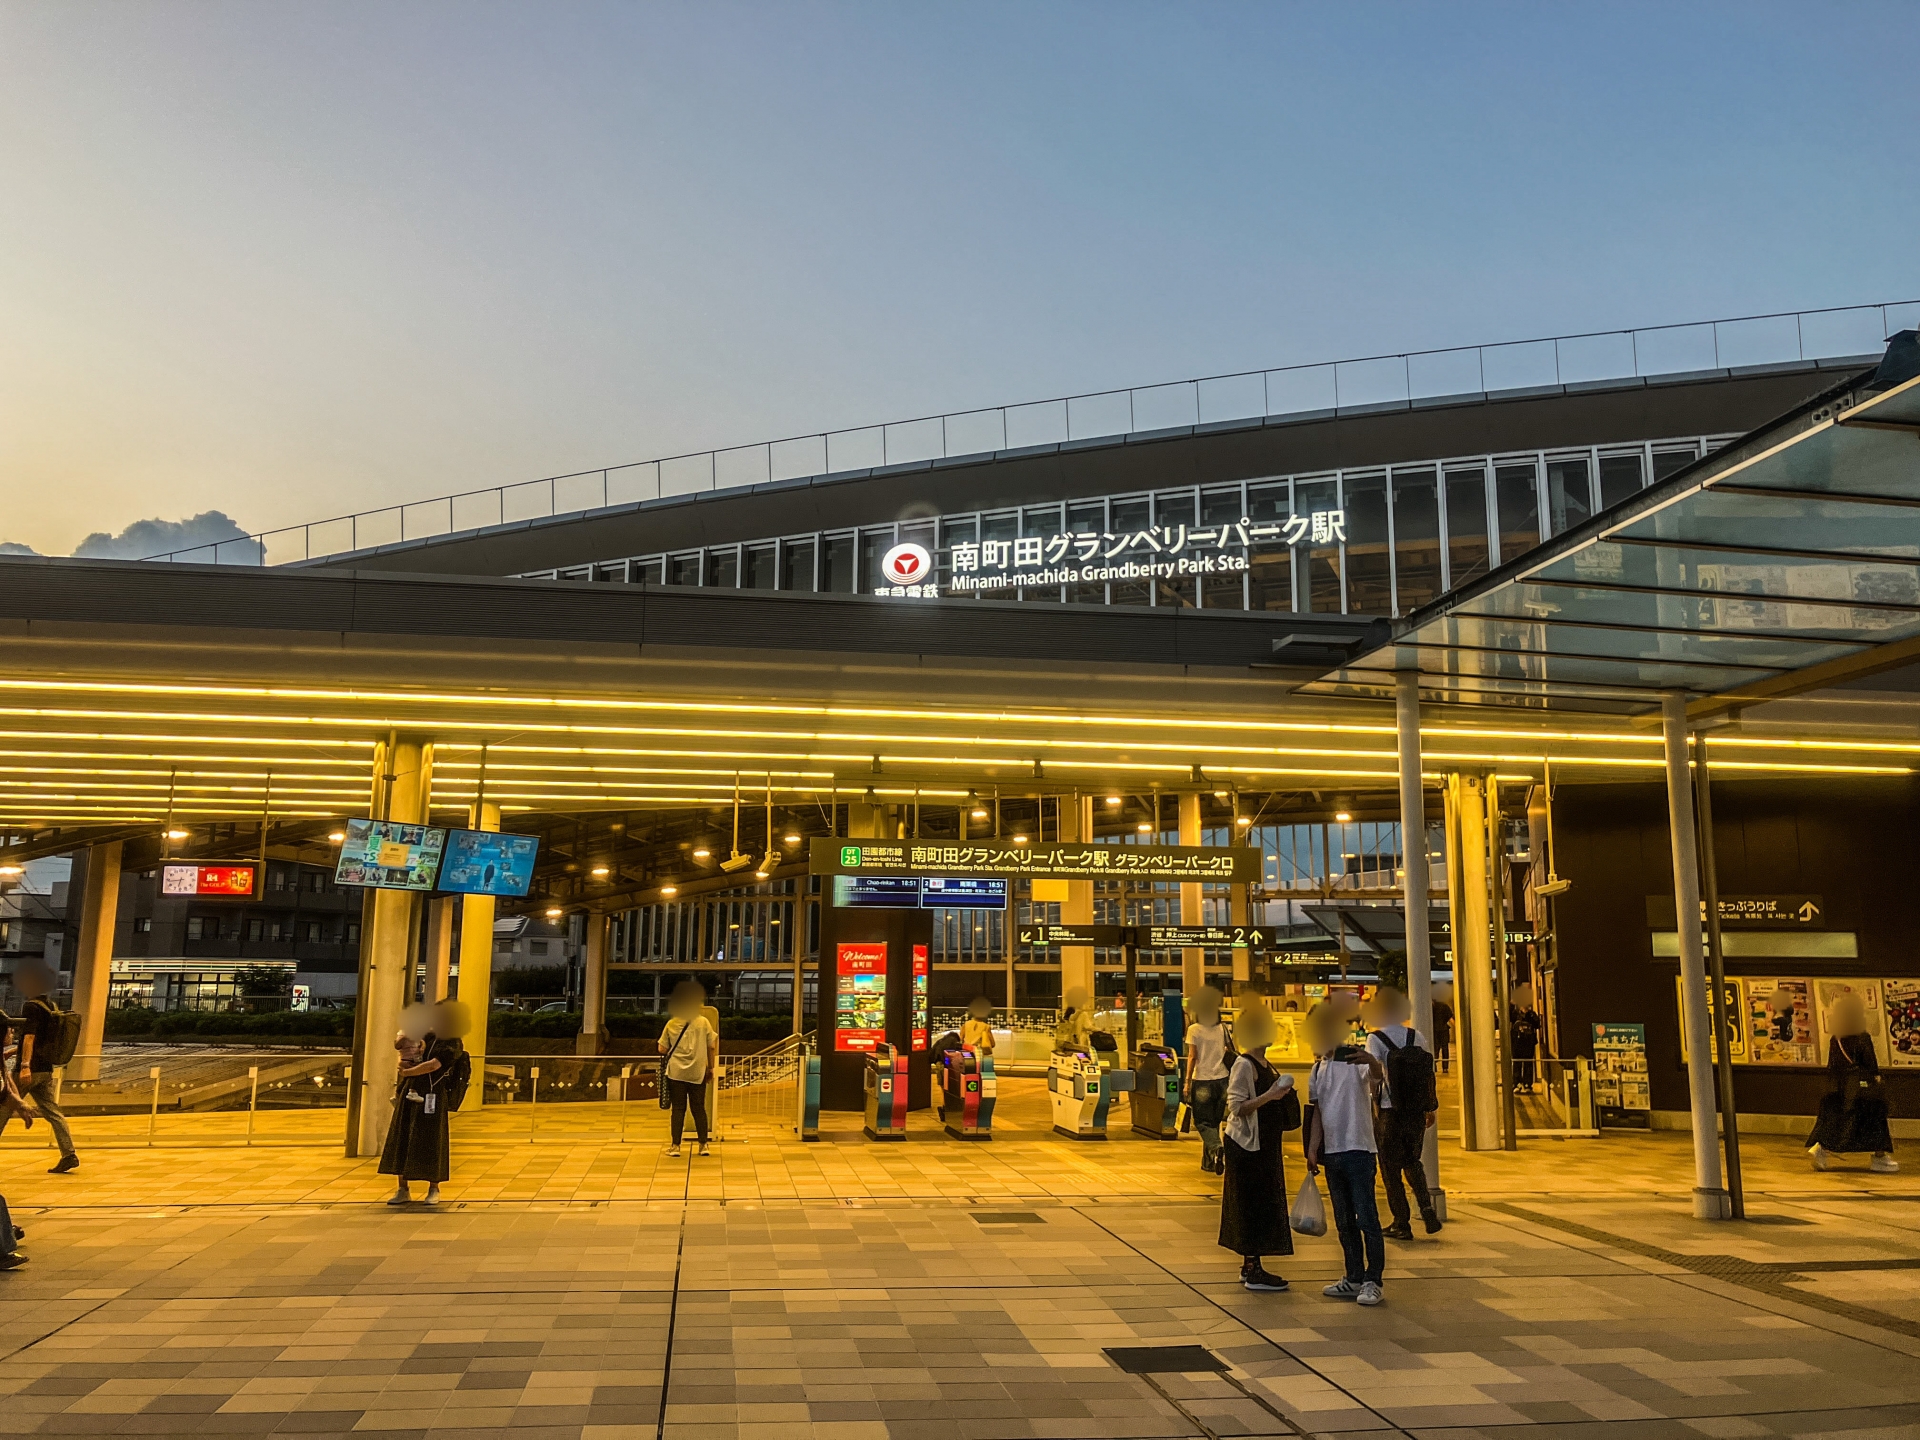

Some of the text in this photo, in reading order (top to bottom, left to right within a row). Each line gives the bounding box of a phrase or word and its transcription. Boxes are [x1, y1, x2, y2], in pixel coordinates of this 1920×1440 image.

[951, 510, 1346, 572] 南町田グランベリーパーク駅
[951, 555, 1250, 590] Minami-machida Grandberry Park Sta.
[845, 856, 857, 864] 25
[911, 847, 1234, 870] 南町田グランベリーパーク駅 グランベリーパーク口
[948, 864, 973, 872] Grandberry
[1718, 901, 1777, 911] きっぷうりば
[1038, 927, 1043, 941] 1
[1234, 928, 1244, 943] 2
[843, 951, 883, 961] Welcome!
